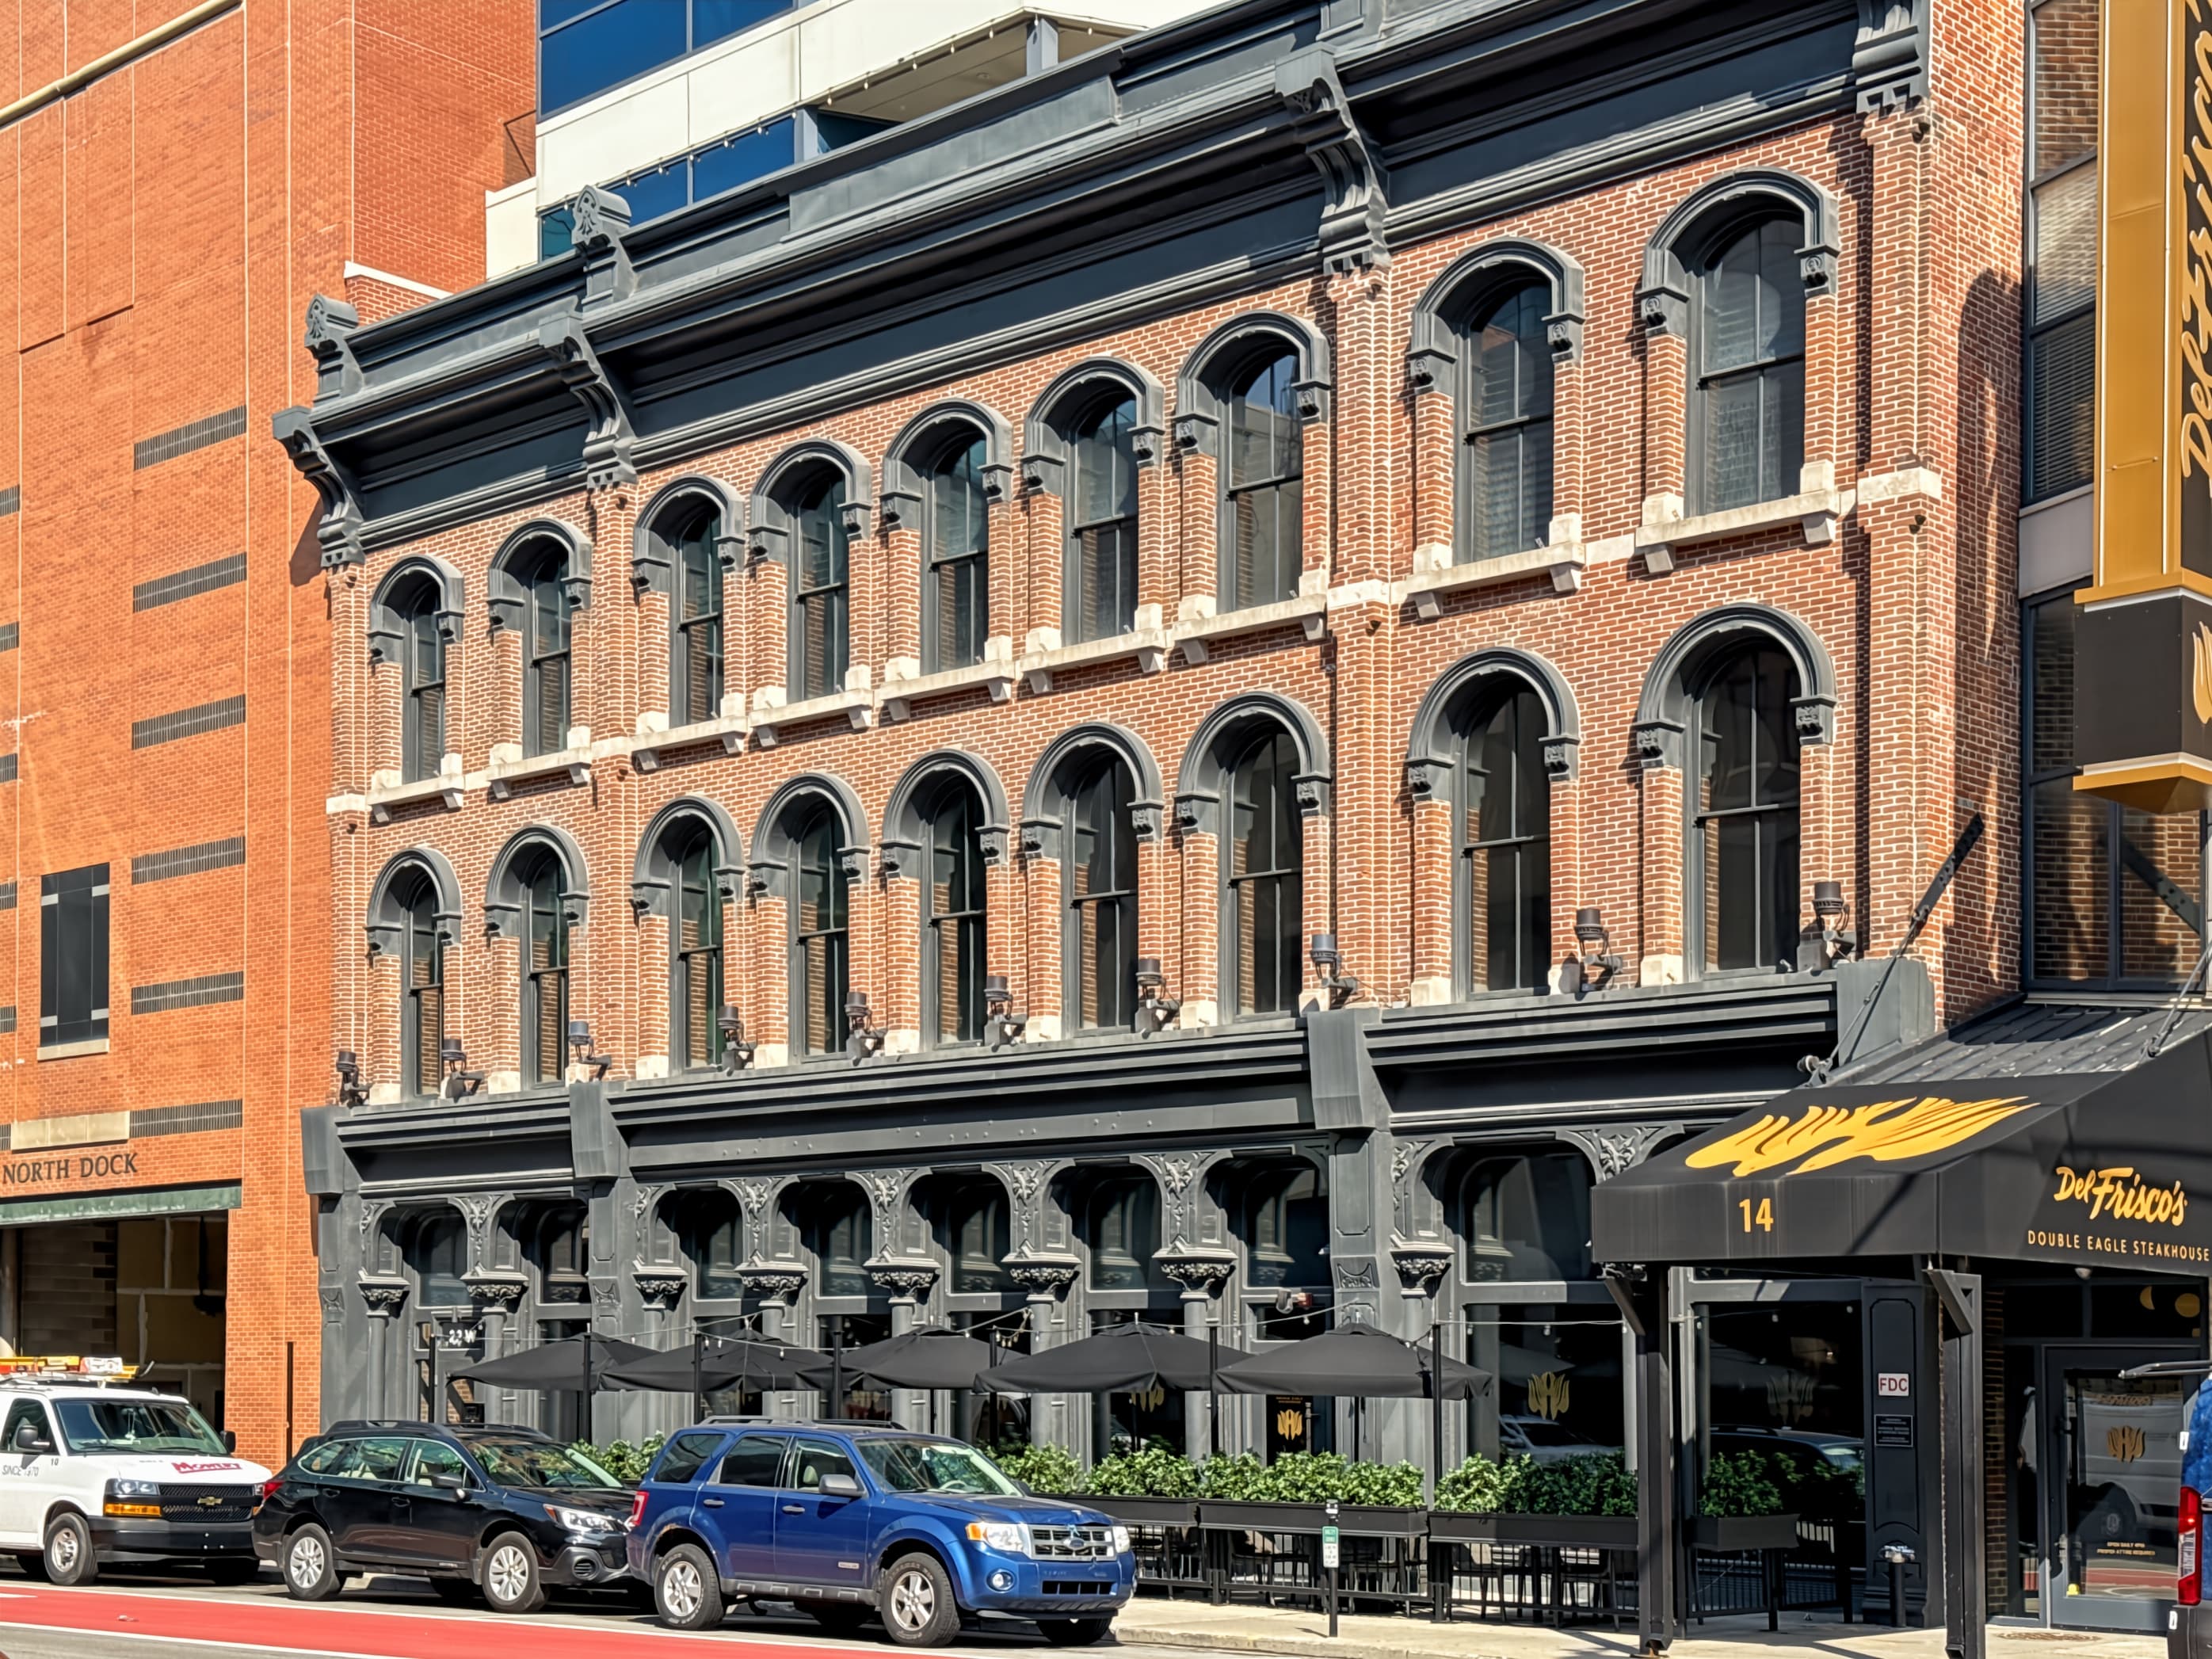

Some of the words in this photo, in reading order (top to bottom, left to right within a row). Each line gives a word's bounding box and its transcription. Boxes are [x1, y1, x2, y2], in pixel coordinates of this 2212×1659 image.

[2, 1158, 70, 1184] NORTH
[80, 1152, 138, 1178] DOCK
[1739, 1198, 1774, 1233] 14
[2027, 1230, 2080, 1249] DOUBLE
[2087, 1235, 2127, 1253] EAGLE
[2133, 1241, 2210, 1261] STEAKHOUSE
[1879, 1377, 1908, 1392] FDC
